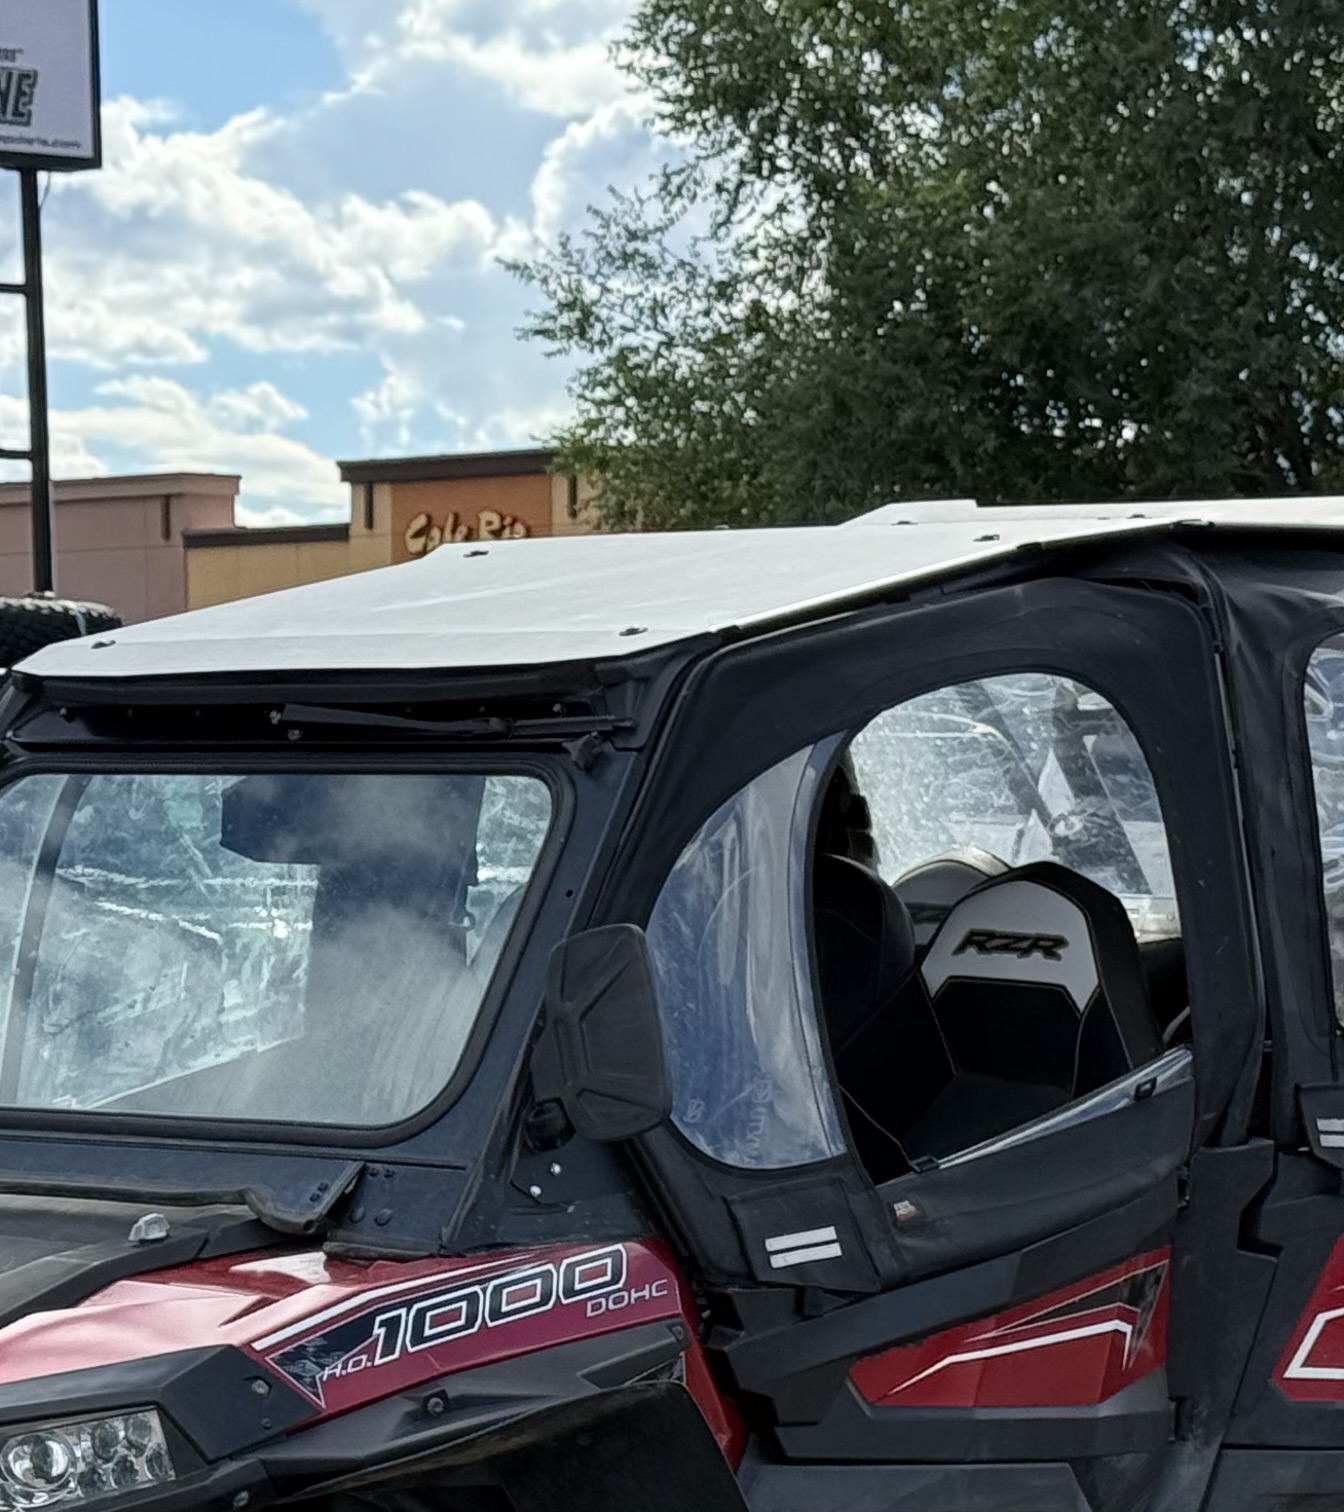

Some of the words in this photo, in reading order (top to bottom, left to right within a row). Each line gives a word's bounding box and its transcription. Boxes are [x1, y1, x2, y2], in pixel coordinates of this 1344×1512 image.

[952, 928, 1070, 961] RZR
[372, 1242, 628, 1367] 1000
[585, 1277, 669, 1318] DOHC
[322, 1354, 372, 1382] H.O.
